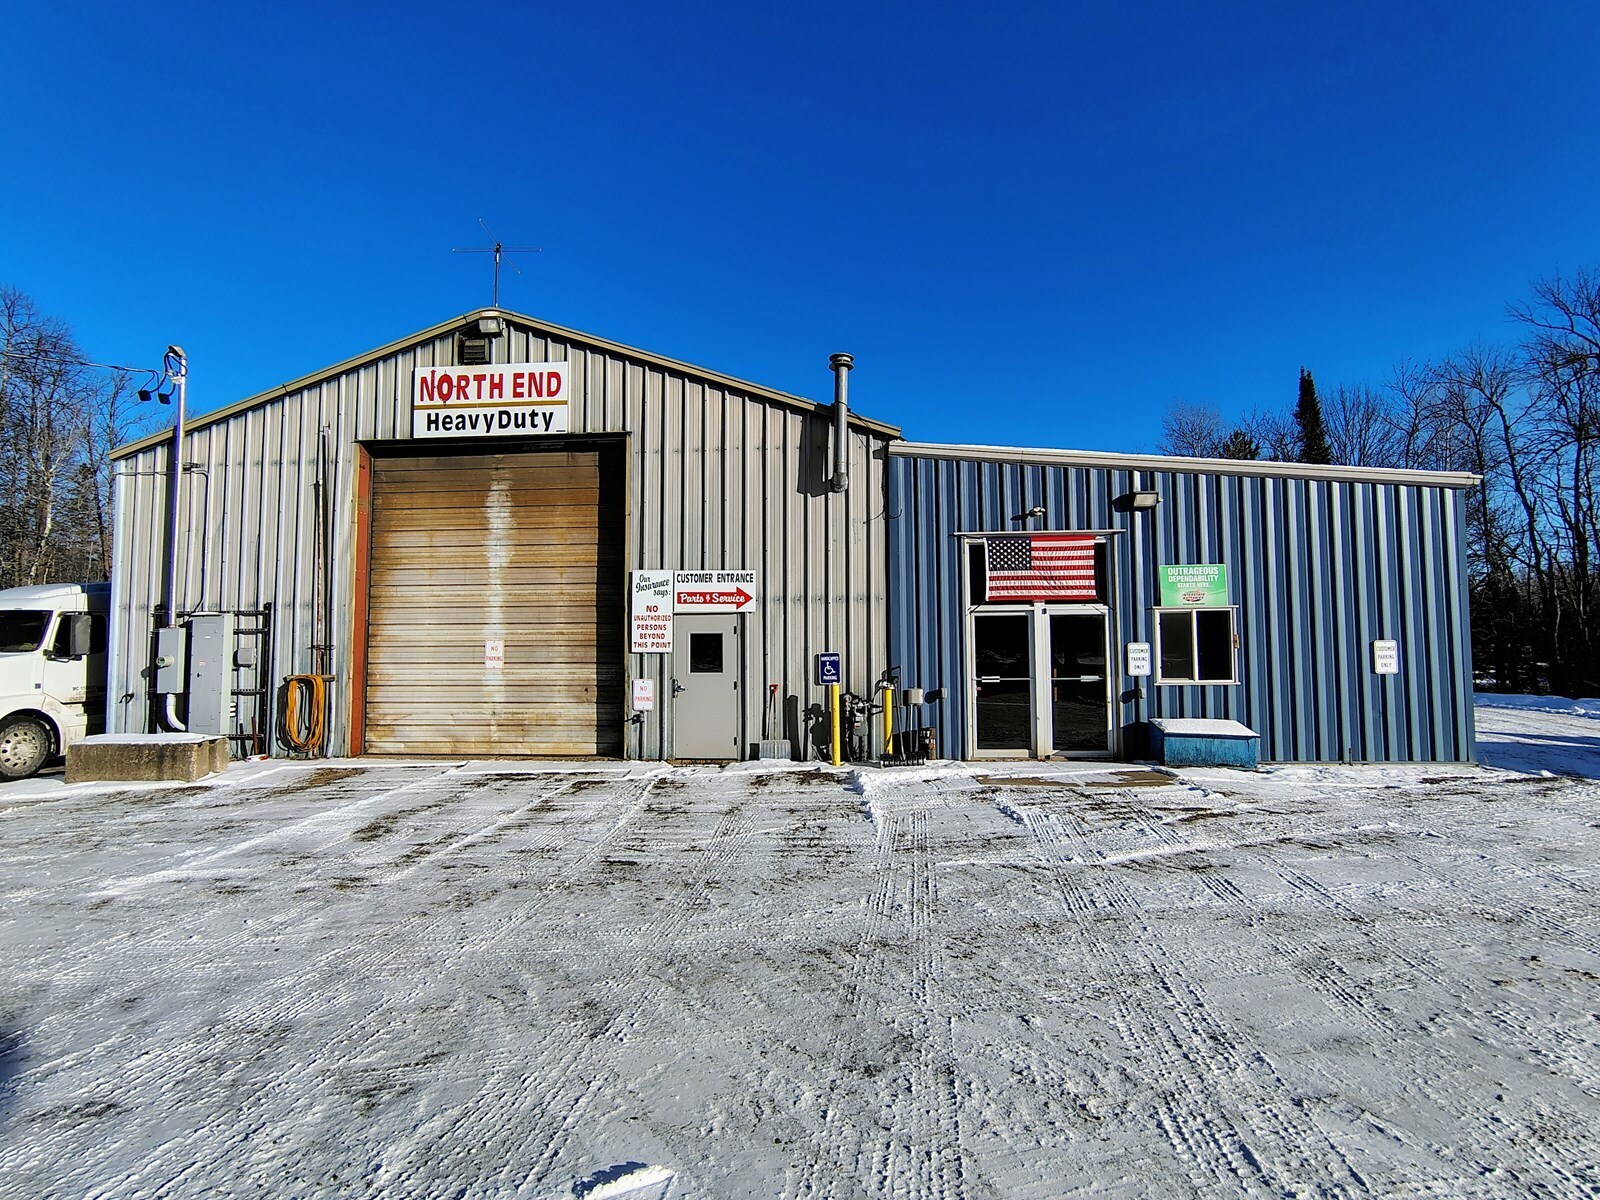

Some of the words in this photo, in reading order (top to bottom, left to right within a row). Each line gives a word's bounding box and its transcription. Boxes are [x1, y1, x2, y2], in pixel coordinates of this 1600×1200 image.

[420, 370, 504, 401] NORTH
[512, 371, 562, 398] END
[1168, 567, 1218, 575] OUTRAGEOUS
[639, 574, 651, 583] Our
[676, 573, 713, 583] CUSTOMER
[717, 573, 754, 583] ENTRANCE
[635, 579, 670, 593] Insurance
[680, 594, 704, 603] Parts
[705, 594, 711, 602] &
[712, 593, 746, 603] Service
[645, 605, 659, 613] NO
[633, 614, 672, 622] UNAUTHORIZED
[633, 641, 649, 649] THIS
[650, 641, 672, 649] POINT
